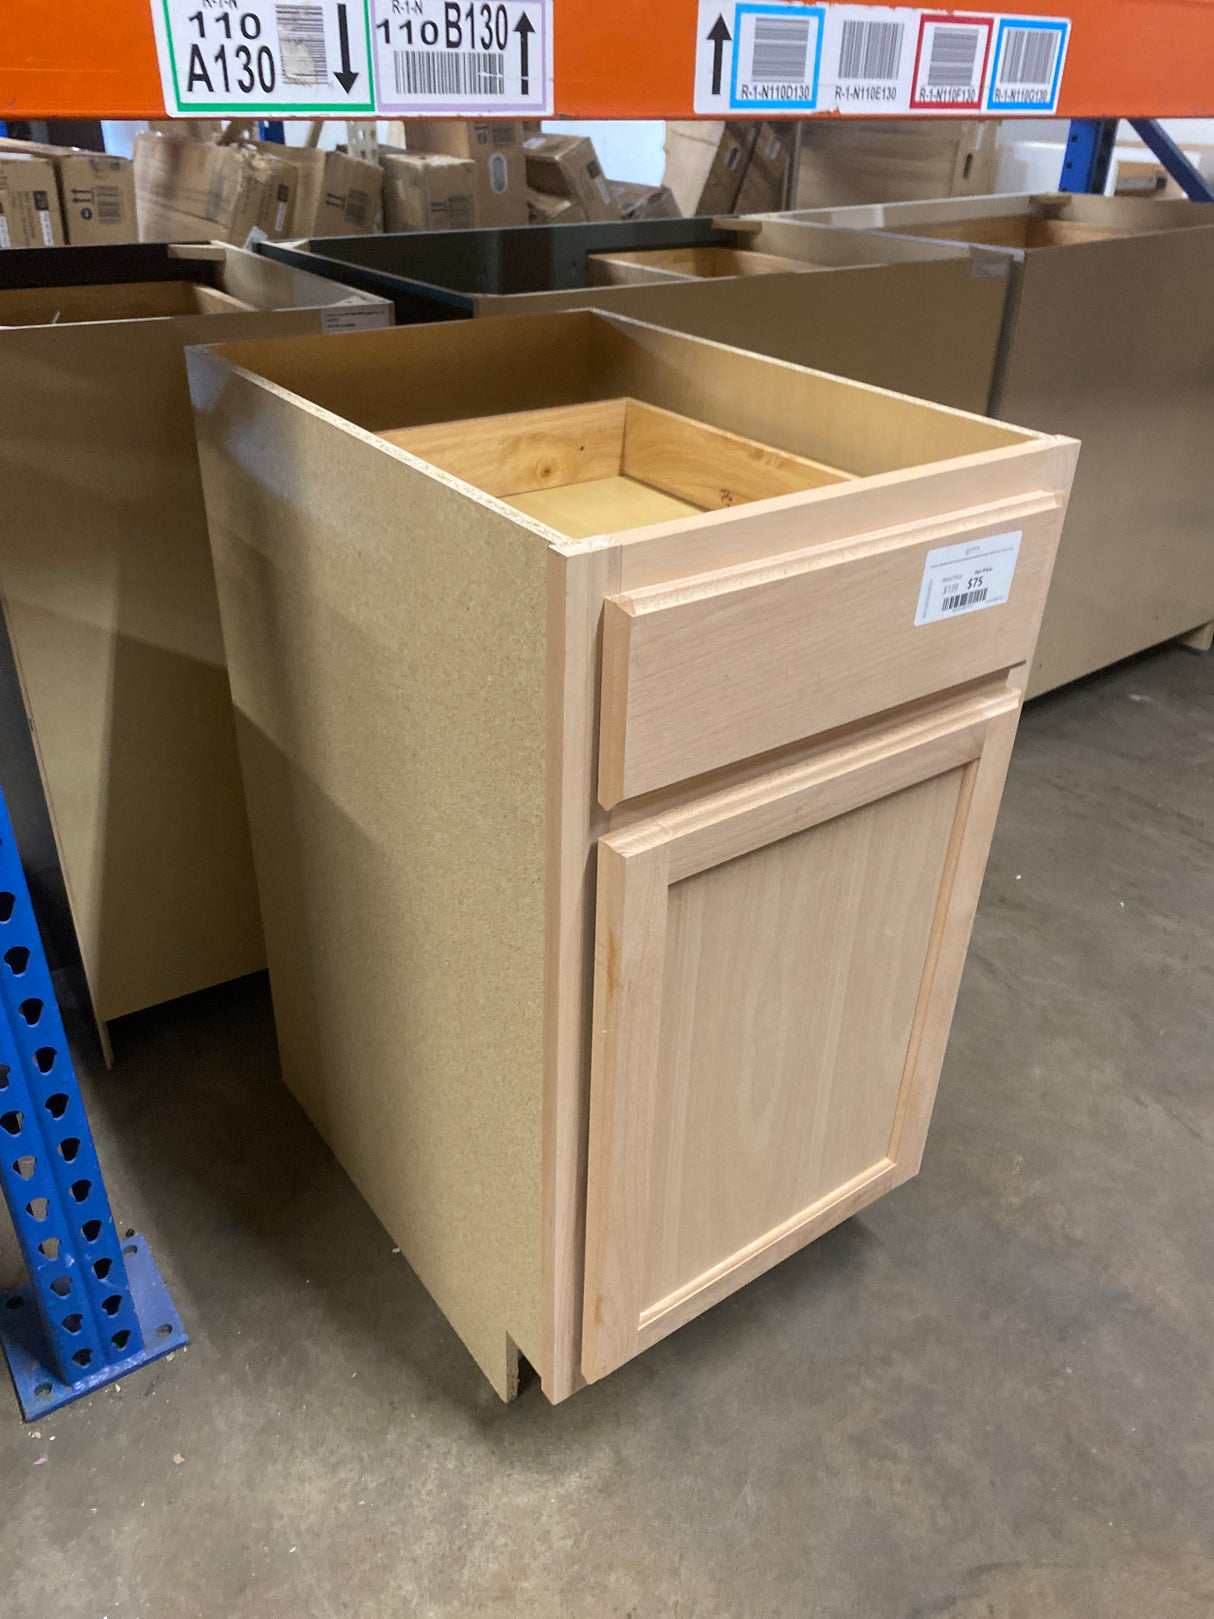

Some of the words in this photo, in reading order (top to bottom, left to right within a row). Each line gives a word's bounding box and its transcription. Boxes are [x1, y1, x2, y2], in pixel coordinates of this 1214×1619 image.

[392, 0, 423, 14] R-1-N
[187, 10, 262, 40] 110
[187, 43, 276, 93] A130
[741, 84, 810, 99] R-1-N110D130
[834, 85, 898, 101] R-1-N110E130
[967, 576, 983, 589] $75
